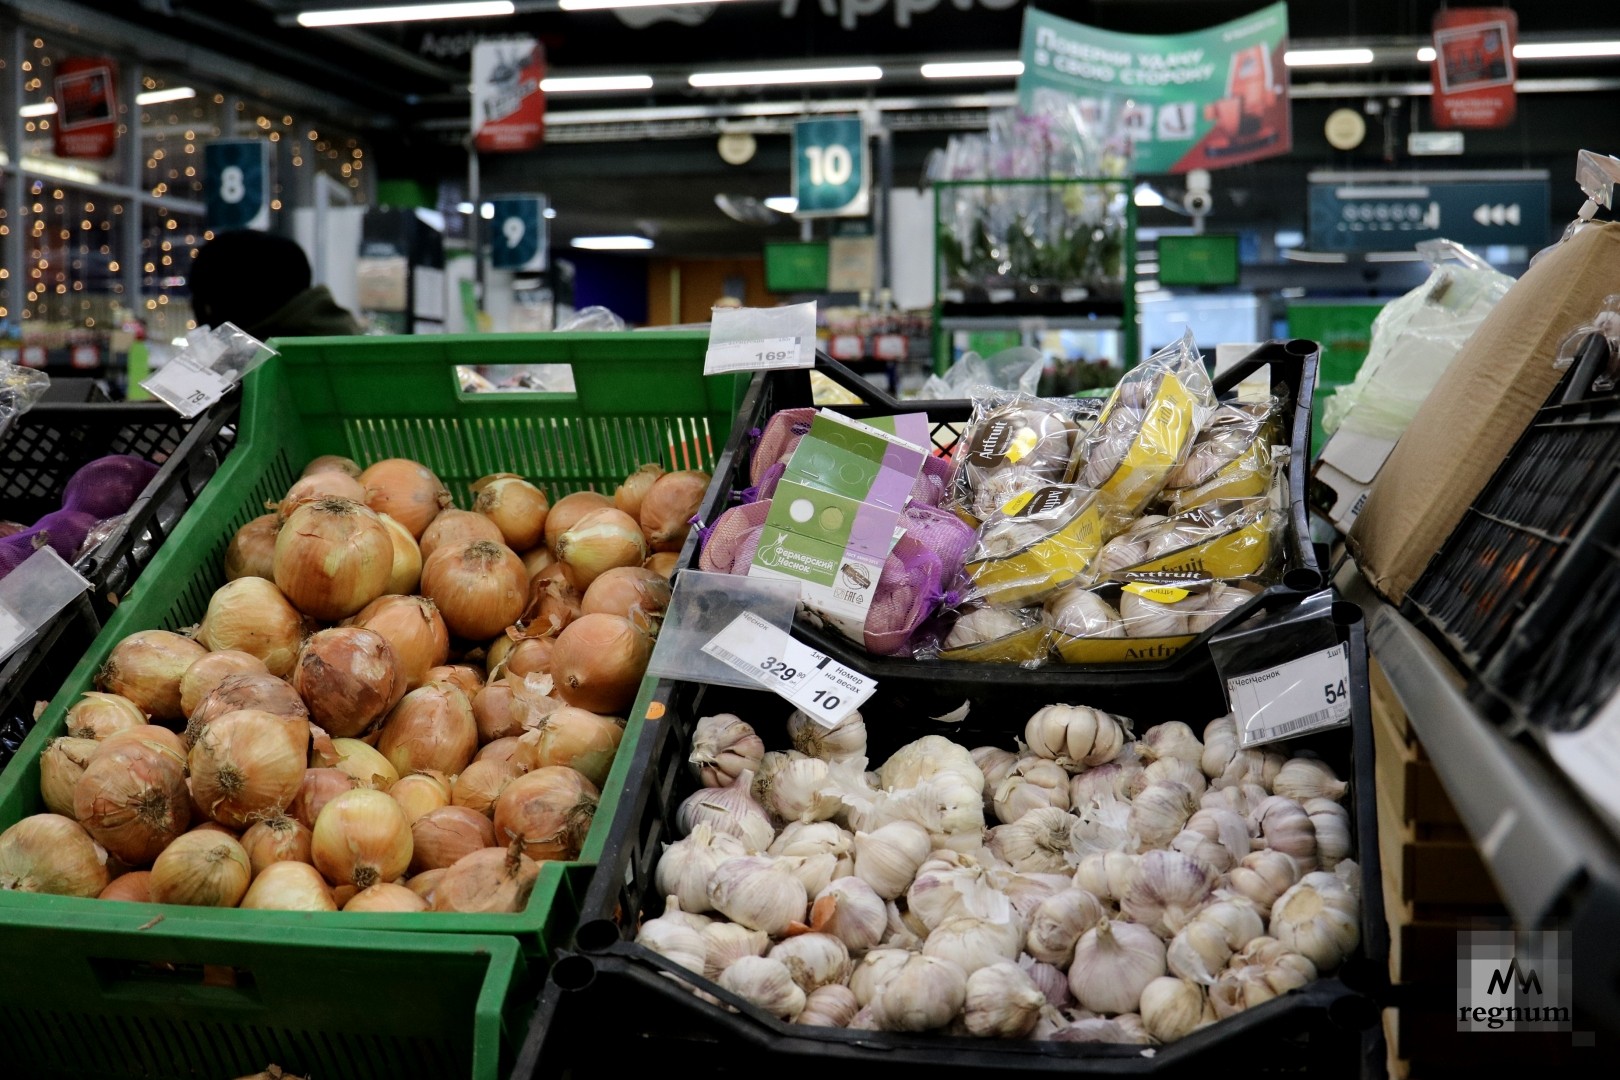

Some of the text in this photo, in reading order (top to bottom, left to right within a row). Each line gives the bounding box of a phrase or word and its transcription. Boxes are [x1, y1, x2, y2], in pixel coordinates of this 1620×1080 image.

[804, 144, 852, 186] 10
[220, 165, 245, 204] 8
[502, 216, 526, 249] 9
[755, 351, 786, 361] 169
[187, 390, 205, 404] 79
[979, 421, 1008, 460] Artfruit
[1125, 571, 1201, 579] Artfruit
[743, 612, 769, 631] Чеснок
[811, 651, 824, 661] 1кг
[760, 656, 797, 681] 329
[836, 667, 863, 685] Номер
[1252, 671, 1281, 683] Чеснок
[825, 672, 861, 694] на весах
[1324, 679, 1347, 704] 54
[813, 690, 841, 710] 10
